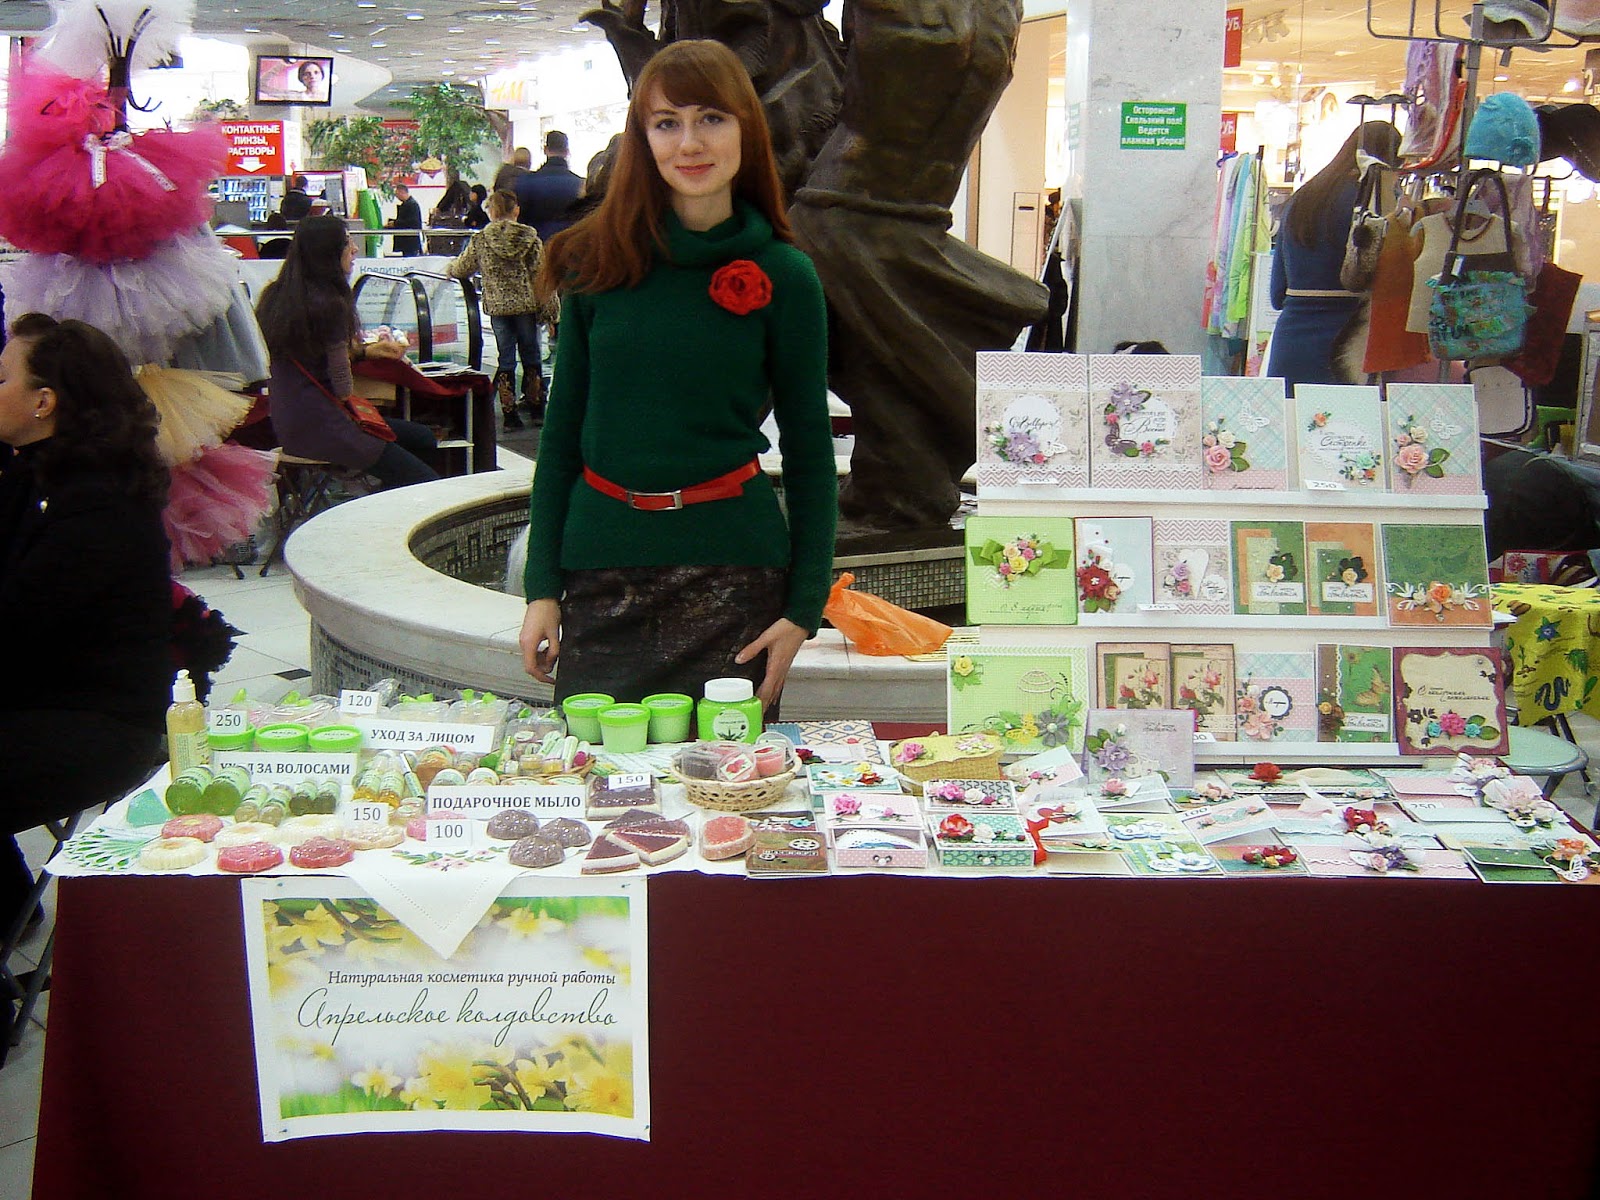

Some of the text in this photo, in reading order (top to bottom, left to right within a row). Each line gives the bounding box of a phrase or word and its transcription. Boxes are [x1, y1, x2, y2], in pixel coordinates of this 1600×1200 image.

[1133, 105, 1176, 115] Осторожно!
[221, 125, 280, 134] КОНТАКТНЫЕ
[1138, 126, 1170, 136] Ведется
[234, 136, 269, 146] ЛИНЗЫ,
[228, 147, 275, 156] РАСТВОРЫ
[348, 694, 373, 708] 120
[215, 714, 241, 727] 250
[371, 728, 476, 745] УХОД ЗА ЛИЦОМ
[256, 763, 273, 775] ЗА
[276, 762, 351, 776] ВОЛОСАМИ
[617, 774, 644, 785] 150
[432, 796, 581, 809] ПОДАРОЧНОЕ МЫЛО
[353, 807, 381, 822] 150
[1184, 807, 1208, 817] 100
[435, 824, 463, 839] 100
[328, 970, 616, 988] Натуральная косметика ручной работы
[297, 987, 618, 1048] Апрельское колдовство
